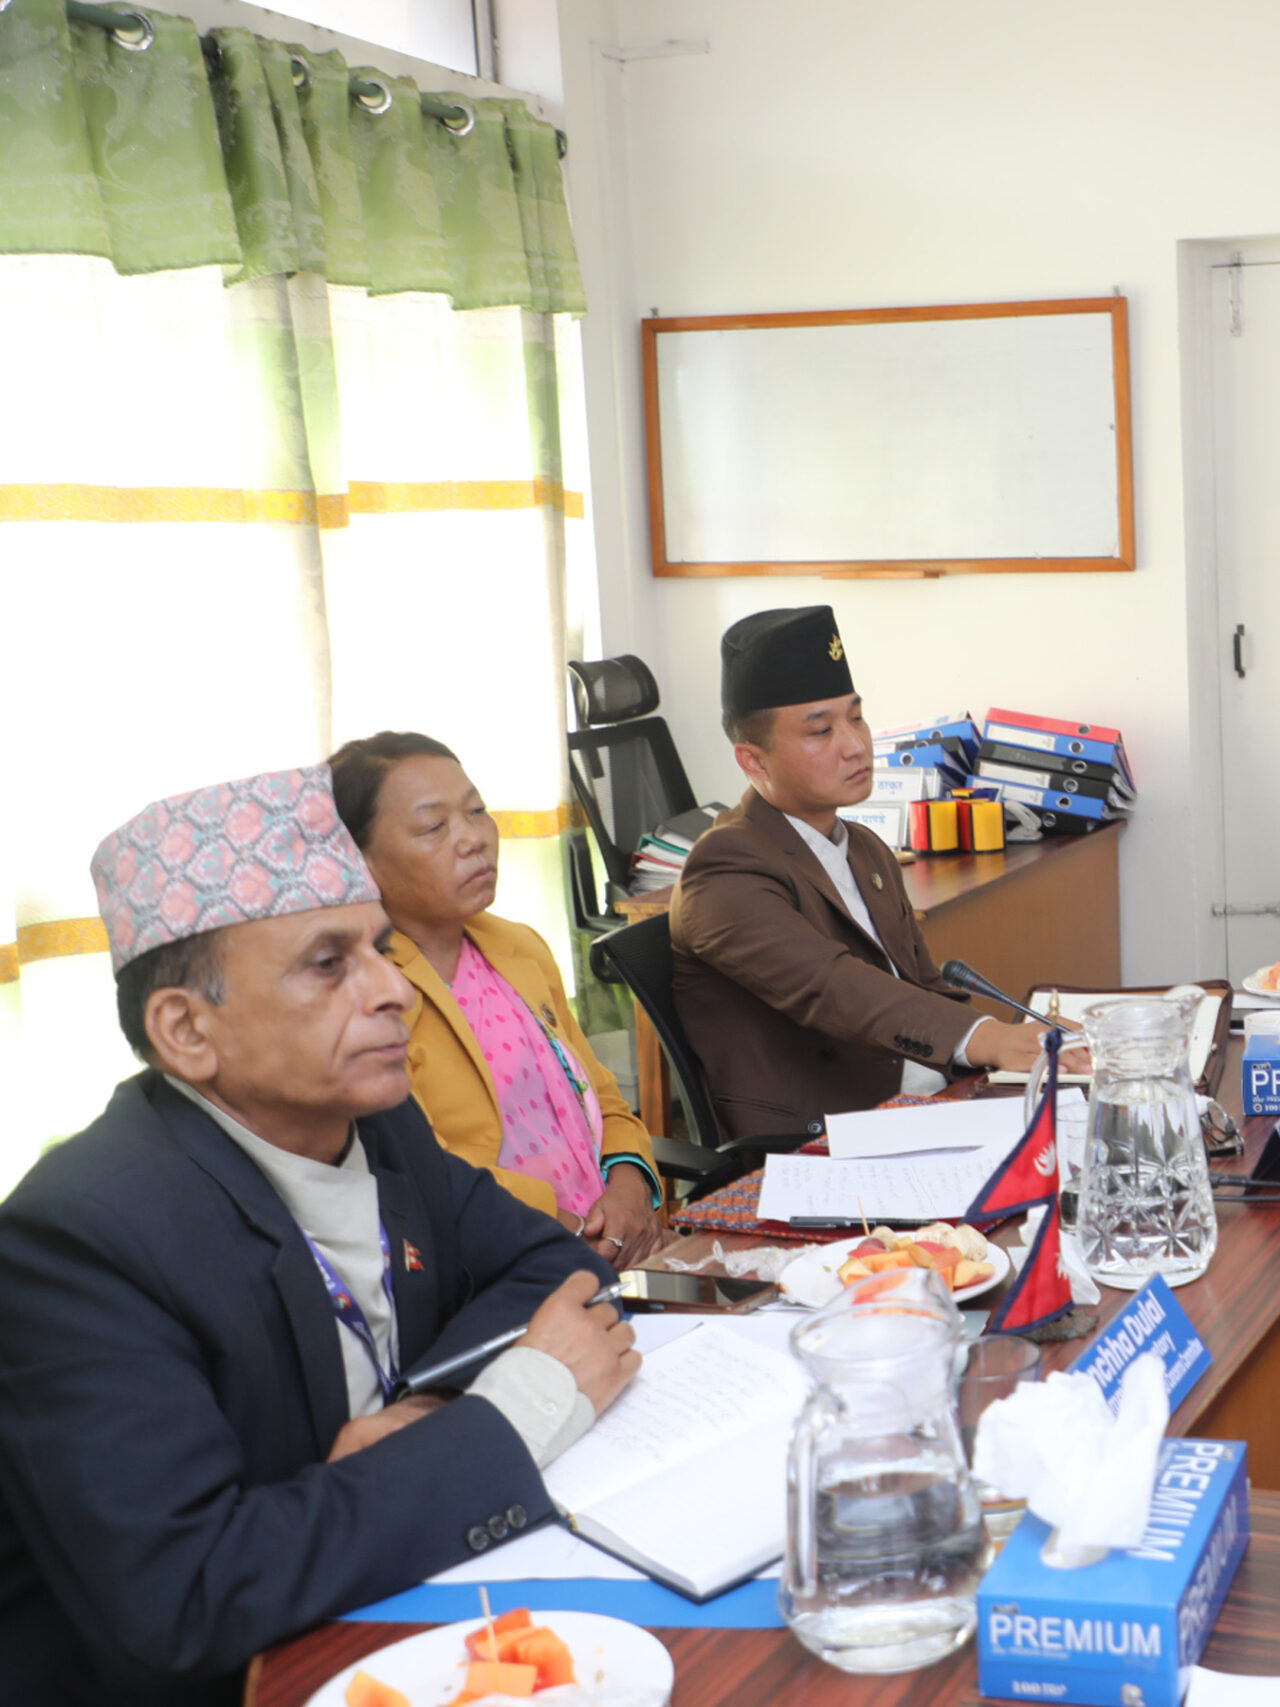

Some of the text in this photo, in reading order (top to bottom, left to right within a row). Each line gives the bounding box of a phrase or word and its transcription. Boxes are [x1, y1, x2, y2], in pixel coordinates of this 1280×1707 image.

[1072, 1329, 1137, 1388] nchha
[1122, 1288, 1167, 1347] Dulal
[989, 1612, 1162, 1658] PREMIUM
